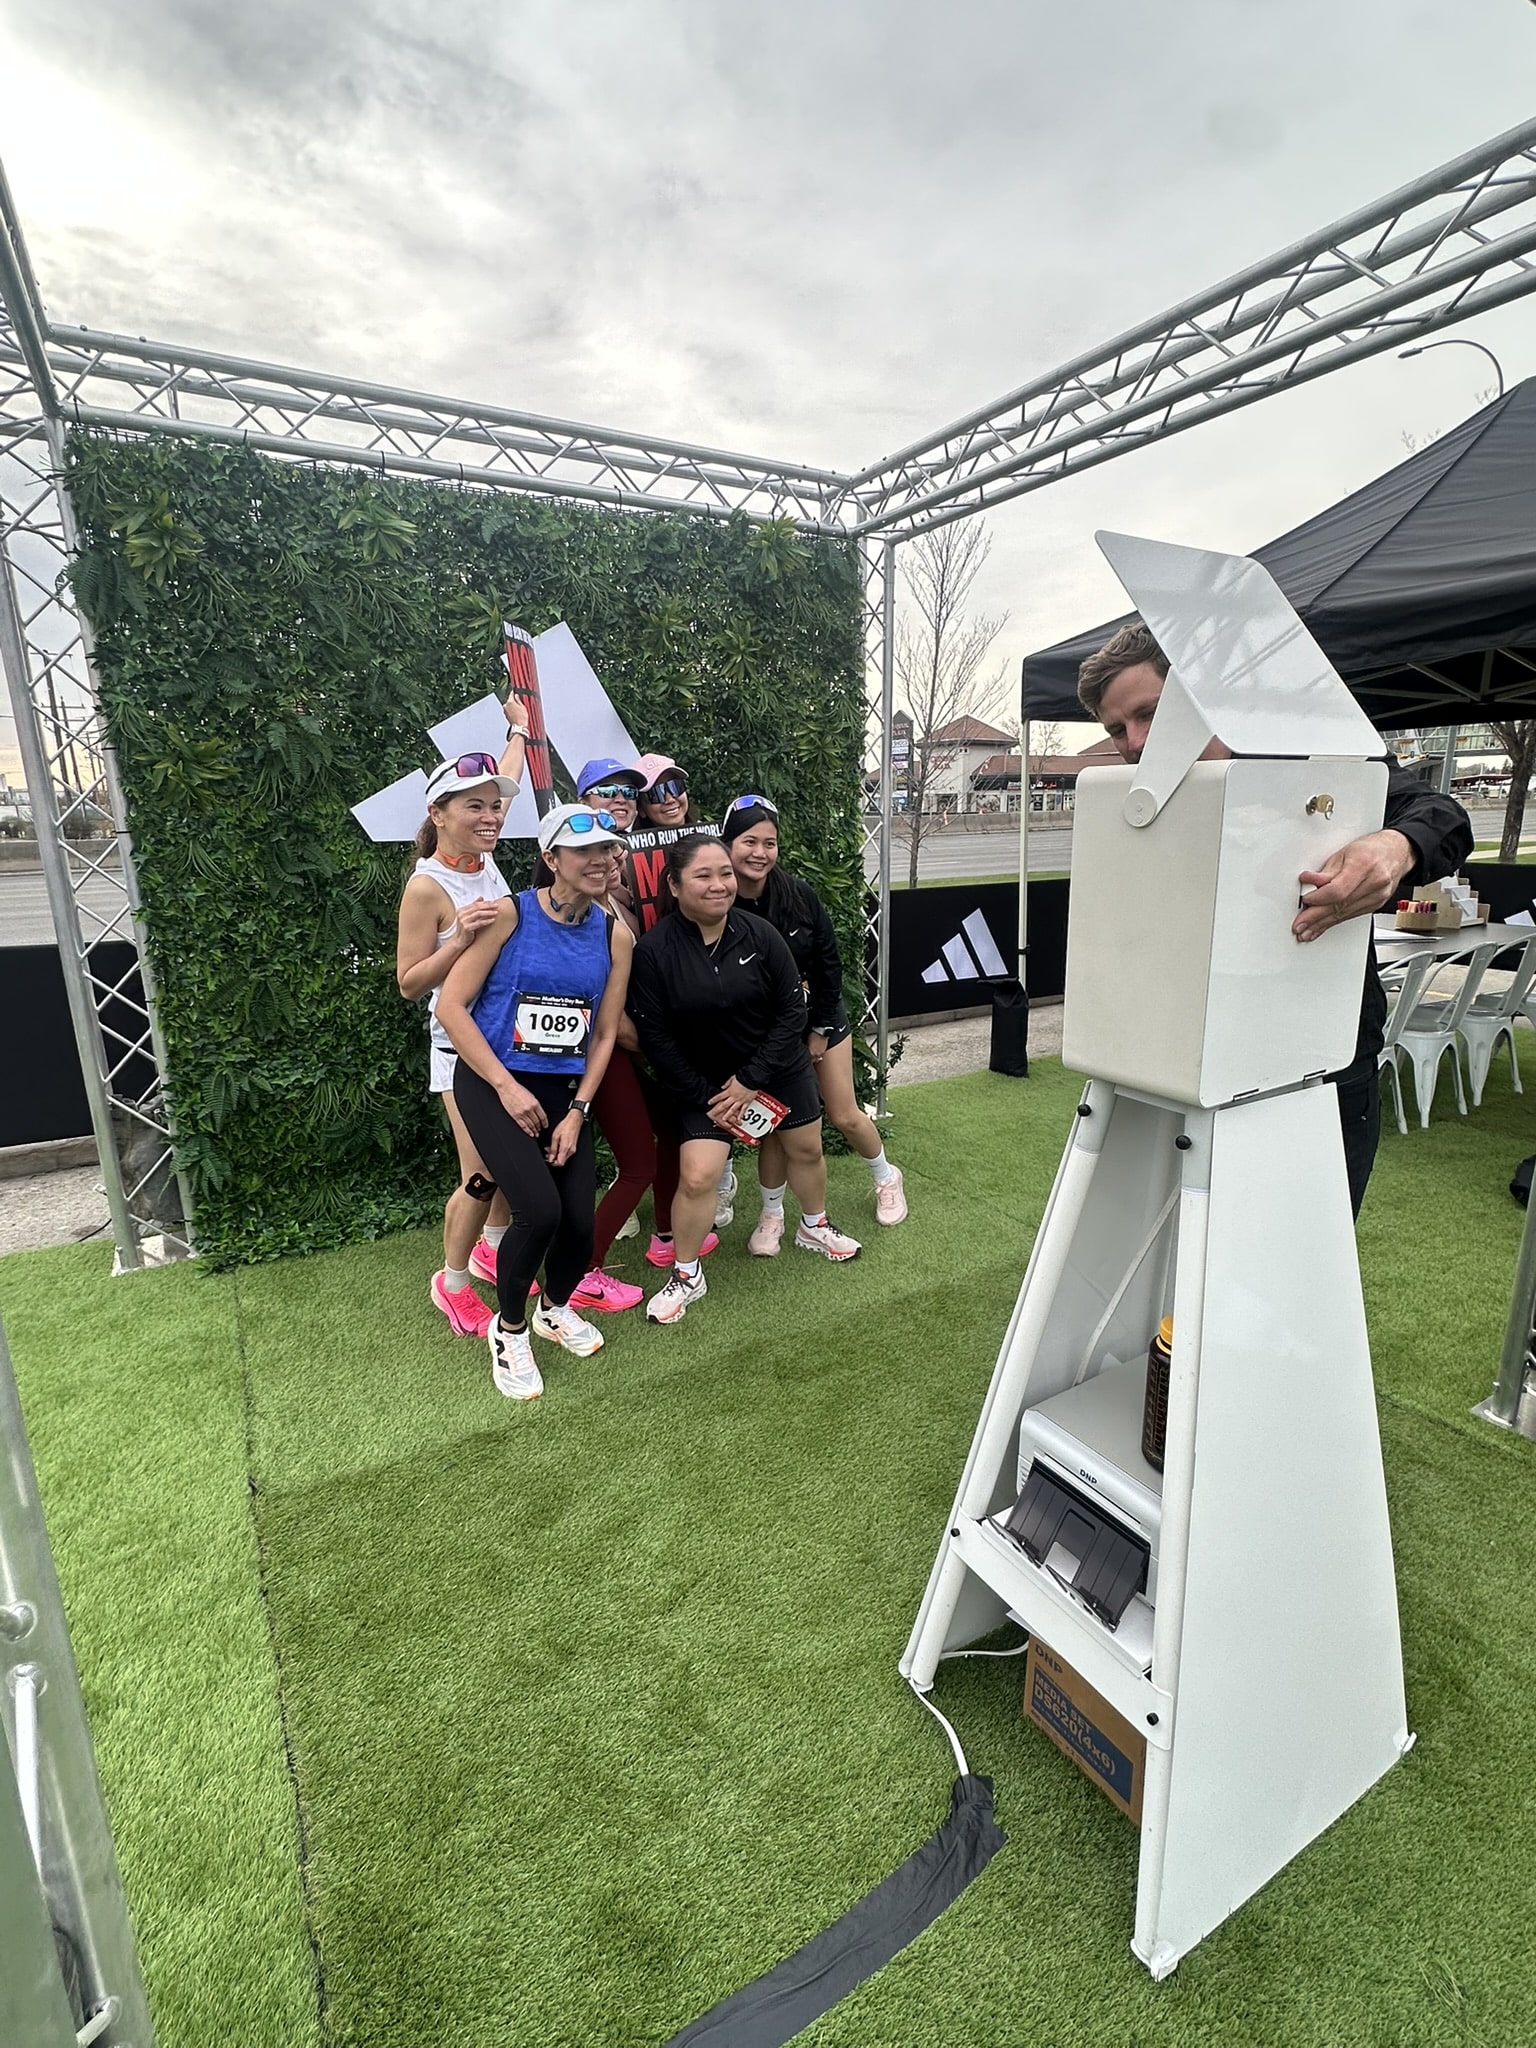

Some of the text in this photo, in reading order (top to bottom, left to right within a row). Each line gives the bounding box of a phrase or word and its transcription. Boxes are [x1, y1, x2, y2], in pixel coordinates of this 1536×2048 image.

[627, 832, 656, 849] WHO
[658, 829, 679, 845] RUN
[695, 823, 724, 837] WORL
[529, 1013, 579, 1033] 1089
[1079, 1468, 1098, 1485] DNP
[1035, 1644, 1063, 1674] DNP
[1035, 1672, 1067, 1712] MEDIA
[1070, 1709, 1093, 1734] SET
[1034, 1682, 1116, 1776] DS620(4x6)
